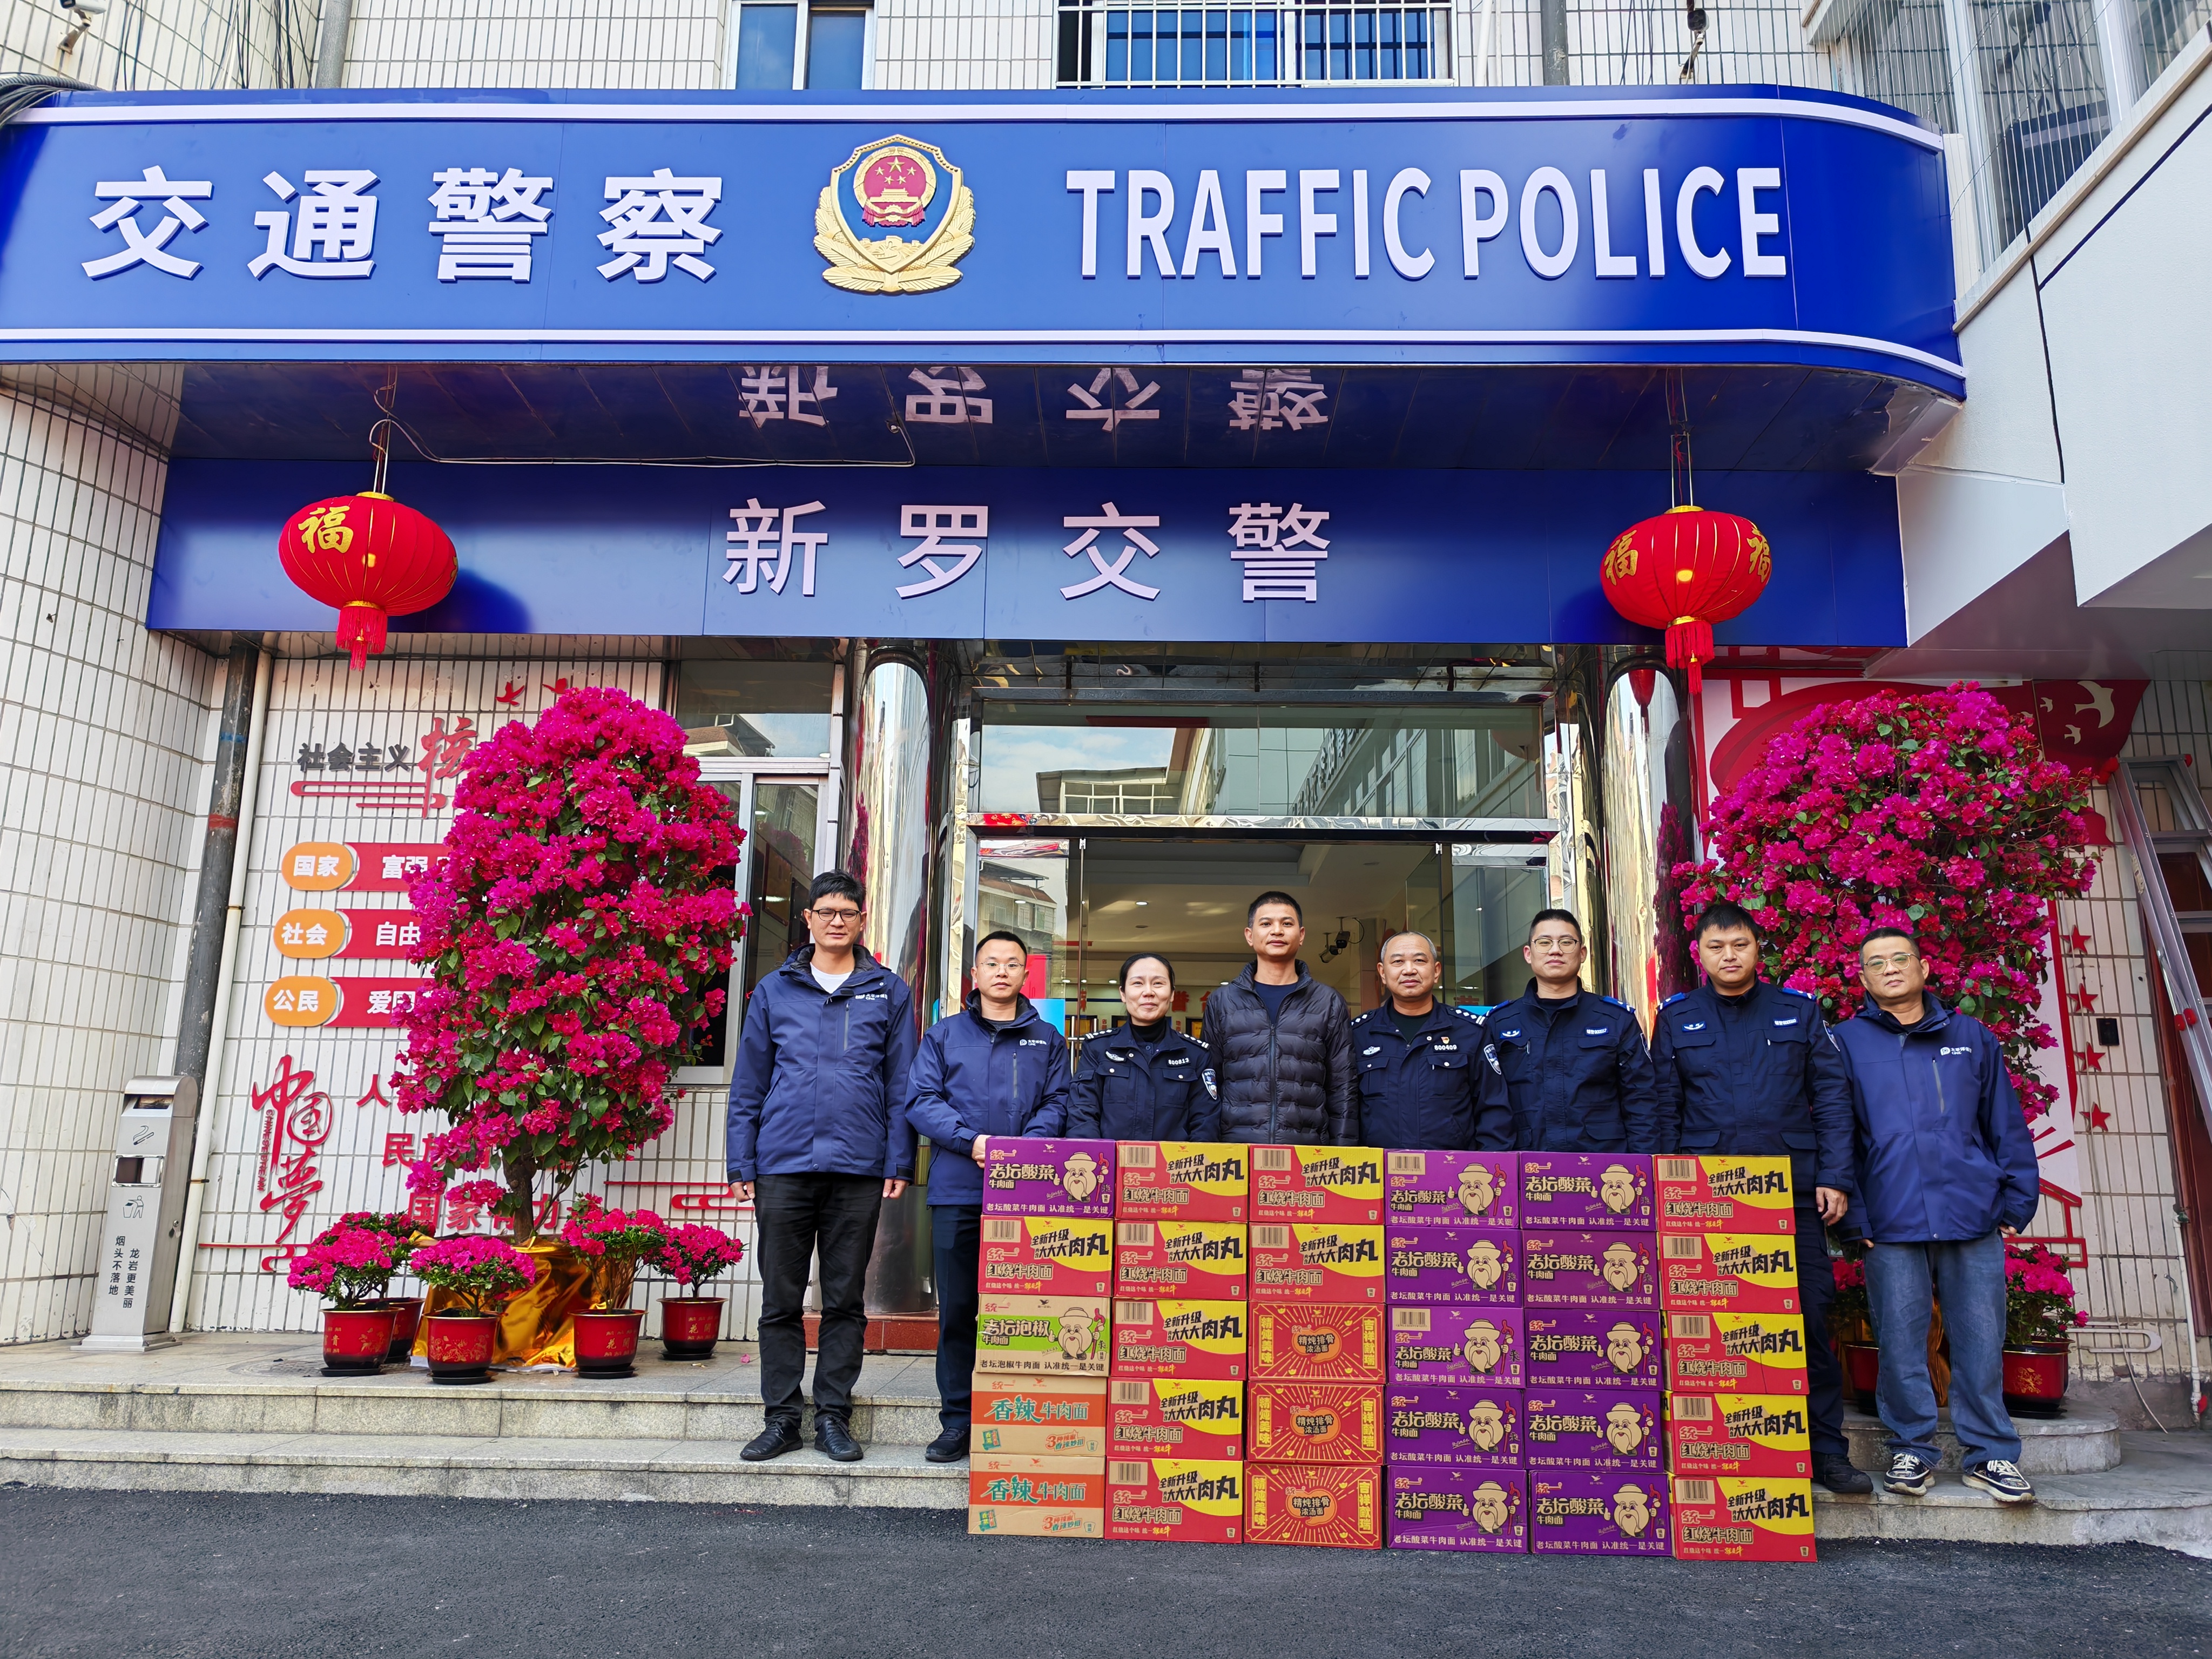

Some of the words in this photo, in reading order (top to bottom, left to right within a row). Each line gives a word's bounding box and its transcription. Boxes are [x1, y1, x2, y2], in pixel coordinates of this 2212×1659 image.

[80, 165, 725, 284] 交通警察
[1065, 167, 1437, 281] TRAFFIC
[1459, 165, 1788, 280] POLICE
[298, 505, 354, 554] 福
[721, 498, 1332, 604] 新罗交警
[1603, 529, 1639, 586] 福
[293, 855, 340, 878] 国家
[281, 922, 328, 946] 社会
[375, 921, 420, 946] 自由
[273, 989, 319, 1013] 公民
[261, 1109, 274, 1152] CHINESE
[252, 1054, 335, 1244] 中国梦
[990, 1150, 1015, 1160] 统一
[1167, 1154, 1204, 1171] 全新升级
[1302, 1157, 1340, 1175] 全新升级
[1525, 1163, 1550, 1173] 统一
[257, 1154, 268, 1192] DREAM
[989, 1163, 1055, 1181] 老坛酸菜
[1123, 1172, 1154, 1185] 统一
[1708, 1167, 1746, 1184] 全新升级
[989, 1180, 1014, 1189] 牛肉面
[1259, 1176, 1289, 1189] 统一
[1391, 1176, 1416, 1186] 统一
[1525, 1176, 1592, 1193] 老坛酸菜
[1123, 1188, 1189, 1203] 红烧牛肉面
[1259, 1191, 1325, 1206] 红烧牛肉面
[1390, 1190, 1446, 1204] 老坛酸菜
[1526, 1193, 1552, 1201] 牛肉面
[1664, 1186, 1695, 1199] 统一
[986, 1203, 1045, 1212] 老坛酸菜牛肉面
[1049, 1204, 1108, 1214] 认准统一是关键
[1391, 1203, 1412, 1211] 牛肉面
[1665, 1201, 1733, 1217] 红烧牛肉面
[1391, 1216, 1450, 1224] 老坛酸菜牛肉面
[1454, 1217, 1513, 1225] 认准统一是关键
[1525, 1216, 1584, 1225] 老坛酸菜牛肉面
[1589, 1217, 1649, 1226] 认准统一是关键
[1031, 1229, 1069, 1246] 全新升级
[1165, 1232, 1203, 1250] 全新升级
[1300, 1235, 1338, 1252] 全新升级
[1392, 1237, 1417, 1248] 统一
[1527, 1240, 1552, 1251] 统一
[987, 1247, 1017, 1260] 统一
[1391, 1251, 1459, 1269] 老坛酸菜
[1713, 1245, 1751, 1263] 全新升级
[108, 1235, 126, 1296] 烟头不落地
[1527, 1254, 1595, 1271] 老坛酸菜
[122, 1248, 140, 1309] 龙岩更美丽
[987, 1263, 1053, 1279] 红烧牛肉面
[1121, 1266, 1187, 1282] 红烧牛肉面
[1256, 1269, 1323, 1285] 红烧牛肉面
[1392, 1268, 1418, 1277] 牛肉面
[1527, 1271, 1553, 1279] 牛肉面
[1670, 1280, 1738, 1296] 红烧牛肉面
[985, 1303, 1009, 1312] 统一
[1164, 1311, 1202, 1328] 全新升级
[1529, 1320, 1555, 1331] 统一
[983, 1336, 1008, 1345] 牛肉面
[1298, 1335, 1334, 1345] 精炖排骨
[1395, 1332, 1421, 1343] 统一
[1721, 1324, 1760, 1343] 全新升级
[1306, 1345, 1328, 1353] 浓汤面
[1529, 1334, 1598, 1352] 老坛酸菜
[1119, 1345, 1186, 1361] 红烧牛肉面
[1394, 1346, 1452, 1361] 老坛酸菜
[1530, 1352, 1556, 1360] 牛肉面
[980, 1360, 1040, 1369] 老坛泡椒牛肉面
[1044, 1362, 1104, 1371] 认准统一是关键
[1395, 1360, 1417, 1368] 牛肉面
[1678, 1360, 1746, 1376] 红烧牛肉面
[992, 1381, 1014, 1390] 统一
[1160, 1391, 1198, 1408] 全新升级
[1391, 1397, 1417, 1407] 统一
[1528, 1400, 1554, 1411] 统一
[1296, 1415, 1333, 1426] 精炖排骨
[1391, 1411, 1460, 1429] 老坛酸菜
[1724, 1406, 1763, 1424] 全新升级
[1305, 1426, 1327, 1434] 浓汤面
[1528, 1415, 1597, 1433] 老坛酸菜
[1115, 1425, 1183, 1442] 红烧牛肉面
[1391, 1428, 1418, 1437] 牛肉面
[1529, 1432, 1556, 1441] 牛肉面
[1681, 1442, 1750, 1459] 红烧牛肉面
[988, 1461, 1010, 1469] 统一
[1159, 1471, 1198, 1489] 全新升级
[1395, 1478, 1421, 1489] 统一
[1535, 1483, 1561, 1494] 统一
[1114, 1490, 1145, 1504] 统一
[1292, 1497, 1330, 1508] 精炖排骨
[1394, 1493, 1464, 1510] 老坛酸菜
[1727, 1489, 1766, 1508] 全新升级
[1114, 1506, 1182, 1523] 红烧牛肉面
[1300, 1508, 1324, 1516] 浓汤面
[1395, 1510, 1421, 1519] 牛肉面
[1535, 1498, 1605, 1515] 老坛酸菜
[1536, 1515, 1563, 1525] 牛肉面
[1394, 1535, 1455, 1545] 老坛酸菜牛肉面
[1460, 1537, 1522, 1547] 认准统一是关键
[1683, 1526, 1753, 1543] 红烧牛肉面
